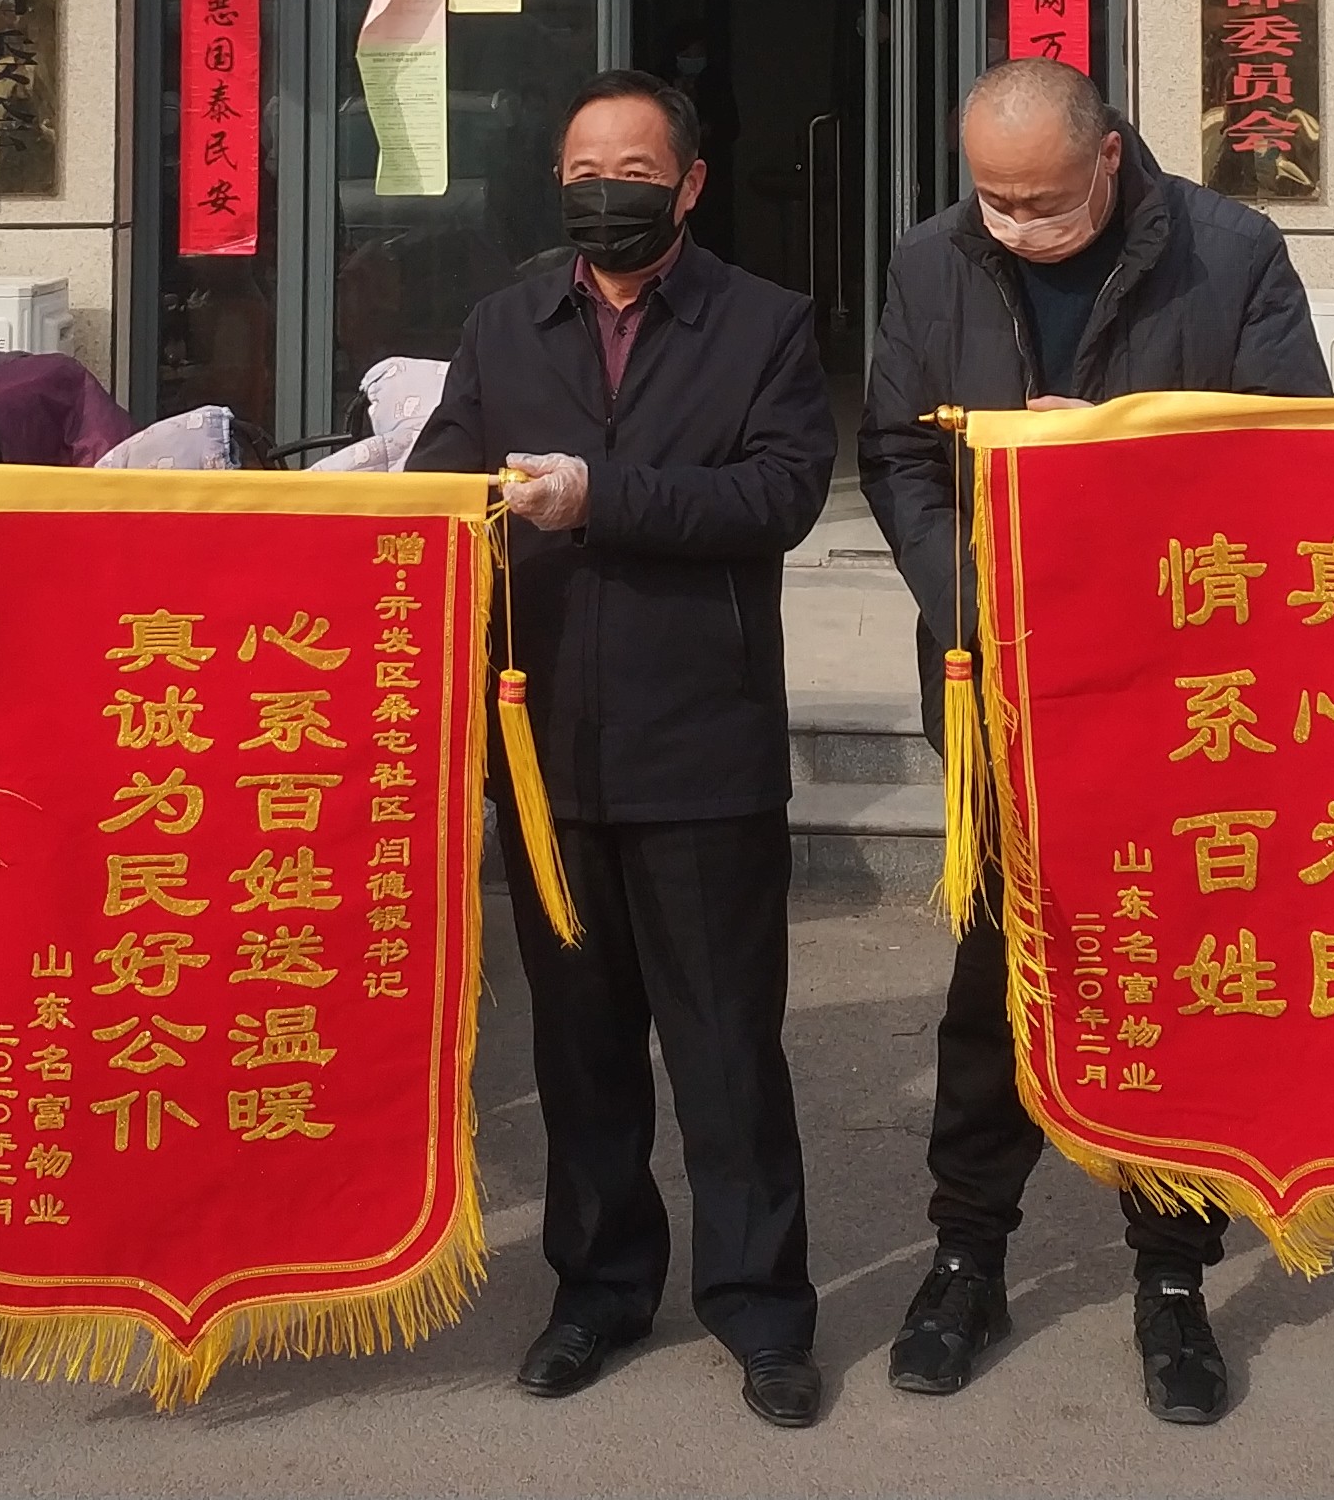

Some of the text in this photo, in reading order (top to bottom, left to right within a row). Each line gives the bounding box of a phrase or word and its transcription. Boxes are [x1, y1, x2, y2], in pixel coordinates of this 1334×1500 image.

[89, 607, 217, 1152] 真诚为民好公仆
[228, 609, 353, 1143] 心系百姓送温暖
[1112, 841, 1163, 1093] 山东名富物业
[1157, 531, 1288, 1018] 情系百姓
[24, 943, 76, 1227] 山东名富物业
